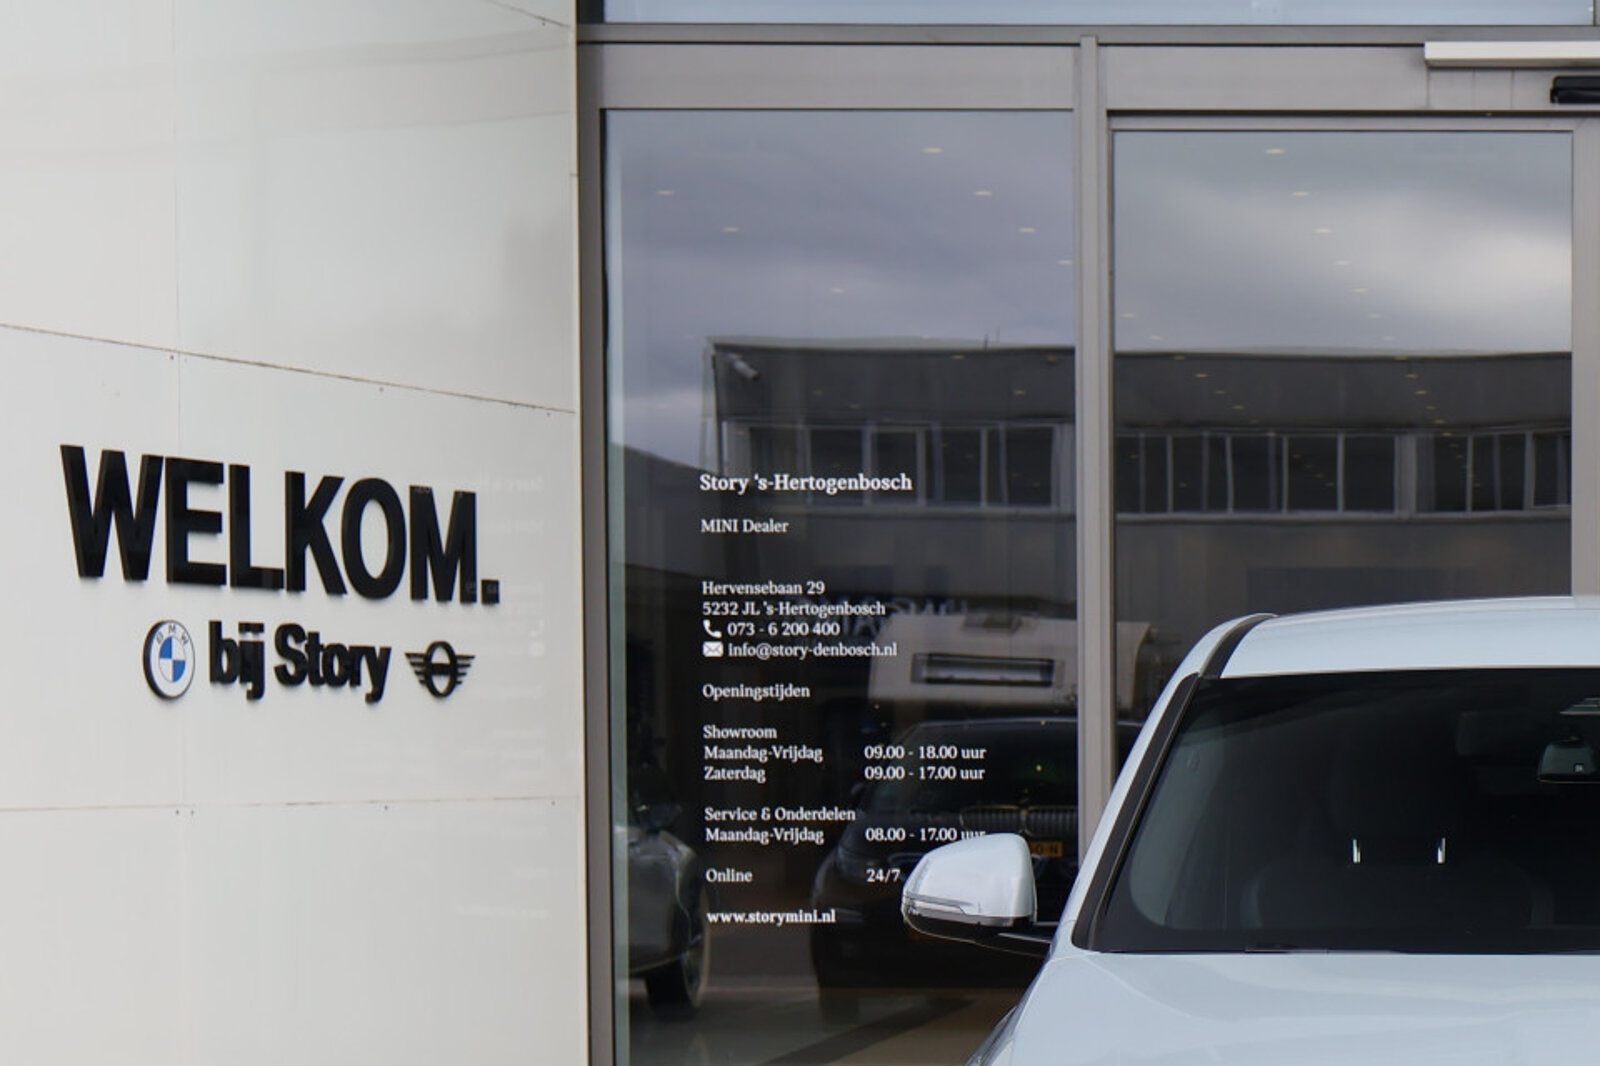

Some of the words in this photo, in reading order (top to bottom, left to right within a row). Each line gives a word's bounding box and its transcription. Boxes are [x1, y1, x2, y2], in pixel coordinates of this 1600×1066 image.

[700, 474, 749, 494] Story
[60, 444, 500, 604] WELKOM.
[702, 519, 737, 532] MINI
[743, 519, 789, 532] Dealer
[703, 580, 802, 594] Hervensebaan
[807, 581, 825, 594] 29
[703, 602, 738, 615] 5232
[742, 602, 760, 615] JL
[728, 622, 755, 635] 073
[768, 623, 777, 635] 6
[782, 622, 809, 635] 200
[813, 622, 840, 635] 400
[729, 641, 898, 660] info@story-denbosch.nl
[209, 620, 265, 702] bij
[275, 623, 391, 703] Story
[703, 683, 810, 701] Openingstijden
[703, 725, 777, 738] Showroom
[705, 745, 823, 762] Maandag-Vrijdag
[865, 745, 905, 759] 09.00
[920, 746, 957, 758] 18.00
[961, 749, 986, 758] uur
[705, 766, 766, 783] Zaterdag
[865, 766, 905, 779] 09.00
[920, 766, 956, 779] 17.00
[960, 770, 985, 779] uur
[705, 807, 757, 820] Service
[761, 807, 770, 820] &
[775, 807, 855, 820] Onderdelen
[706, 827, 824, 844] Maandag-Vrijdag
[865, 828, 905, 840] 08.00
[921, 828, 957, 841] 17.00
[706, 868, 752, 882] Online
[867, 869, 900, 882] 24/7
[707, 909, 835, 926] www.storymini.nl
